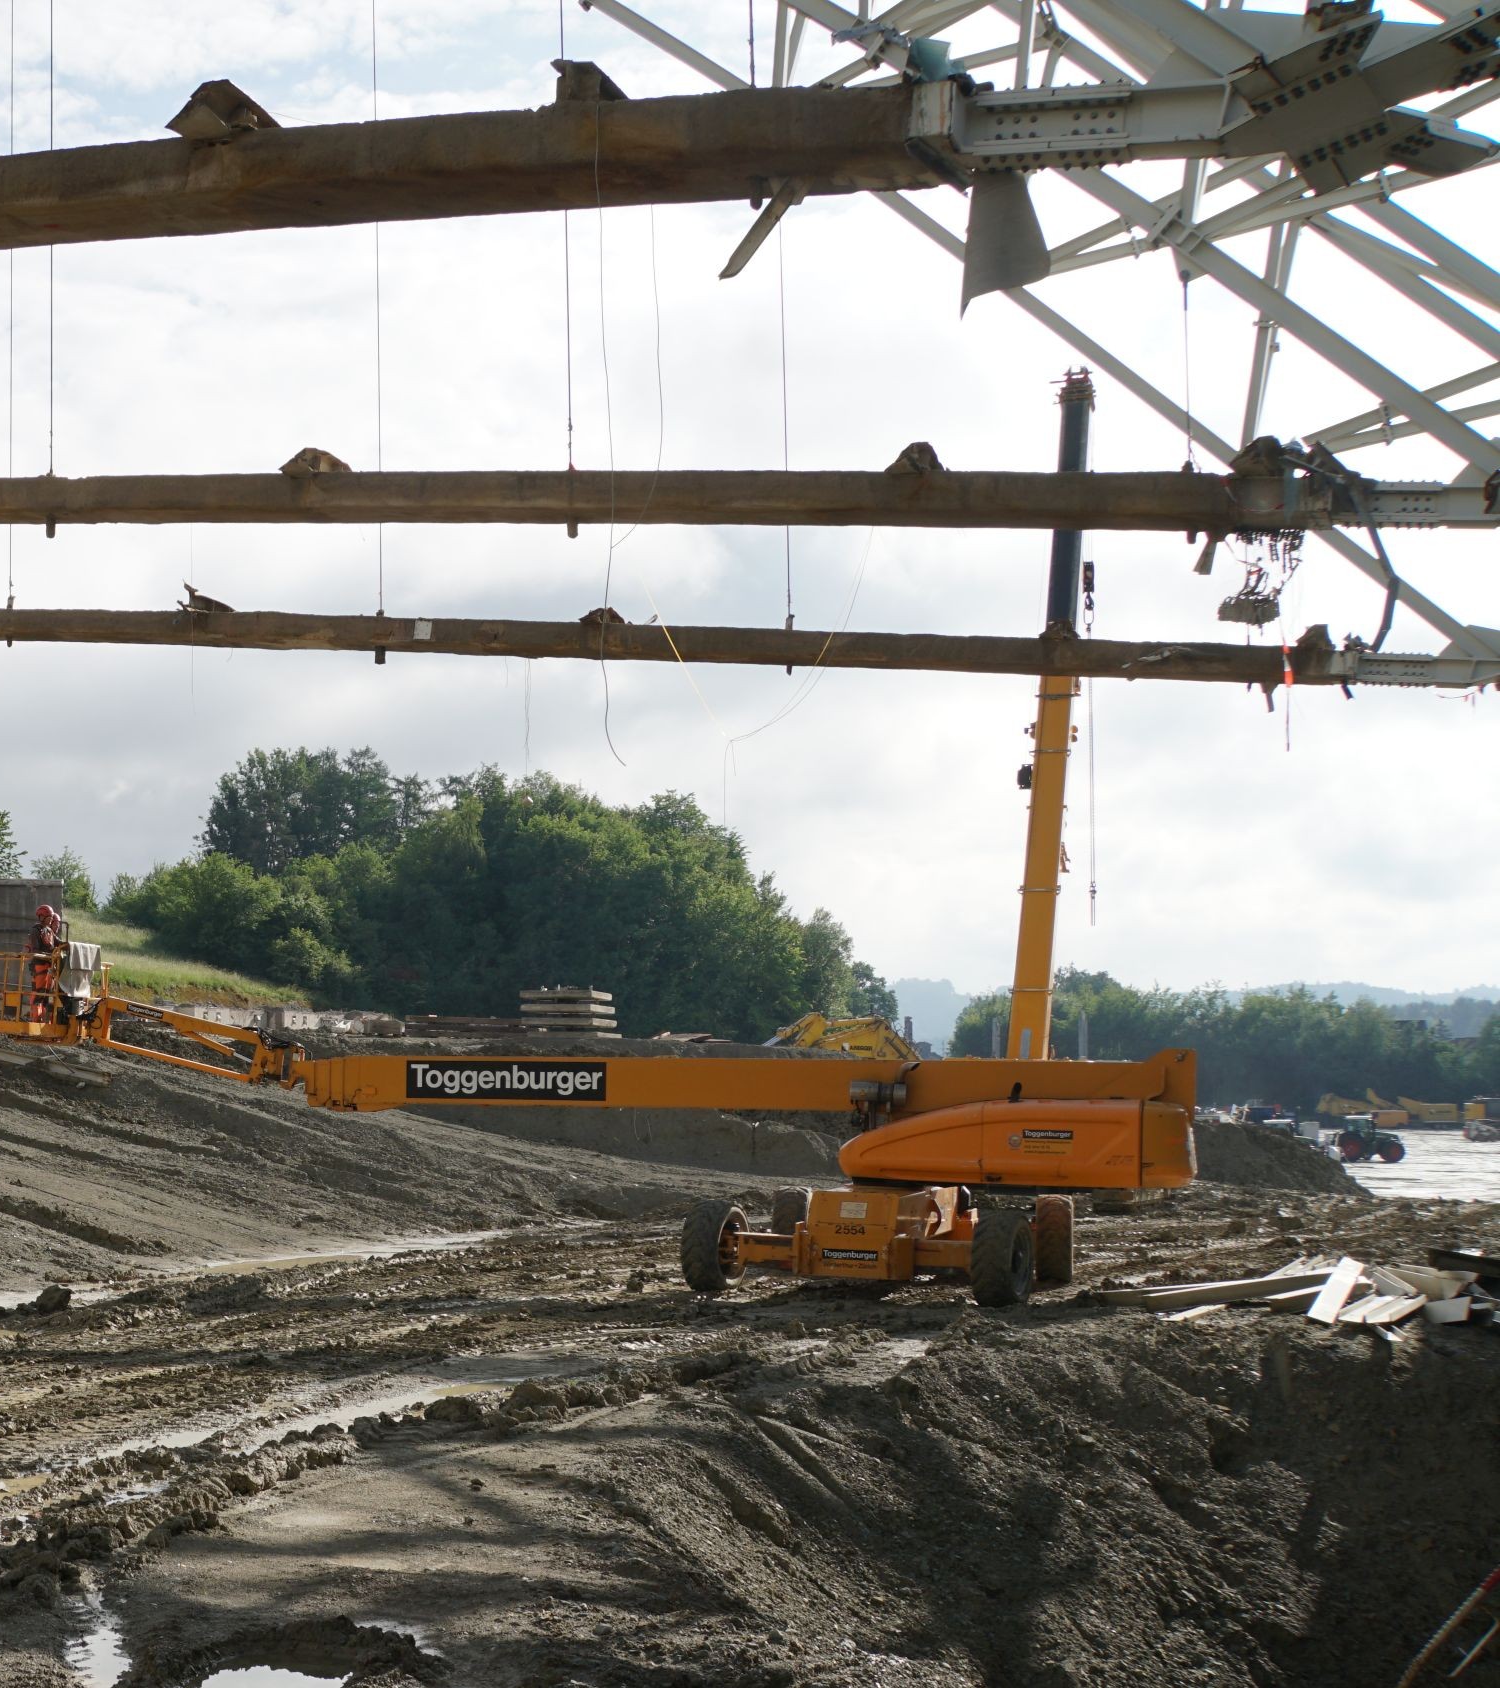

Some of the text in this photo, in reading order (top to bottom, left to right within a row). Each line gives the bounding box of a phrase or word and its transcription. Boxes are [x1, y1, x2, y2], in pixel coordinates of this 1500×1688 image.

[128, 1004, 163, 1017] Toggenburger
[411, 1063, 603, 1096] Toggenburger
[1024, 1130, 1072, 1138] Toggenburger
[835, 1225, 866, 1235] 2554
[823, 1249, 877, 1260] Toggenburger
